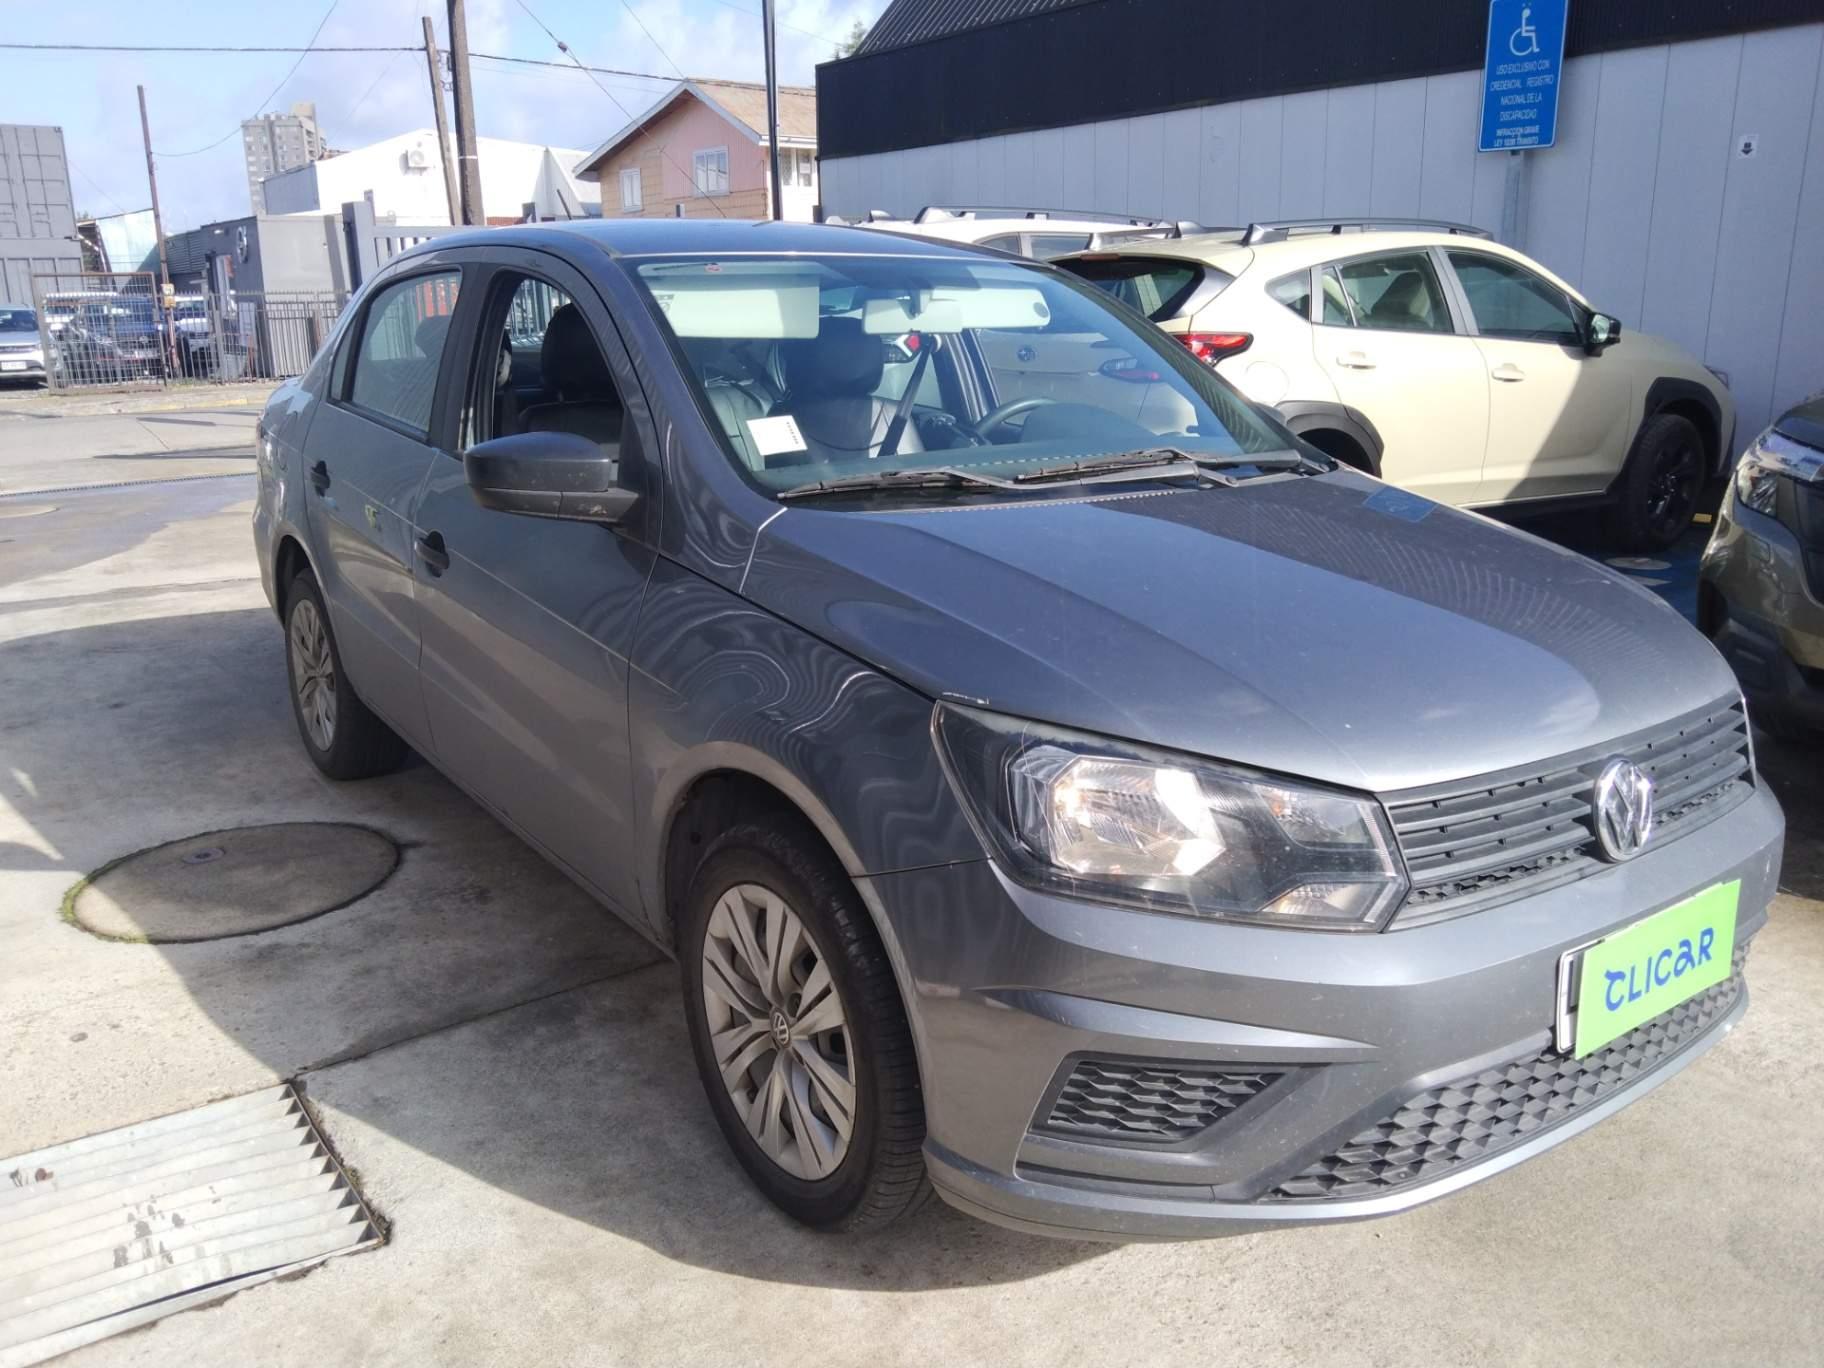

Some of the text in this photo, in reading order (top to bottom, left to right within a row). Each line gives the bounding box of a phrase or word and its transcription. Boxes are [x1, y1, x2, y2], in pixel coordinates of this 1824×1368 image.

[1496, 64, 1508, 75] USO
[1538, 60, 1550, 71] CON
[1490, 79, 1522, 91] CREDENCIAL
[1501, 94, 1526, 105] NACIONAL
[1535, 92, 1542, 103] LA
